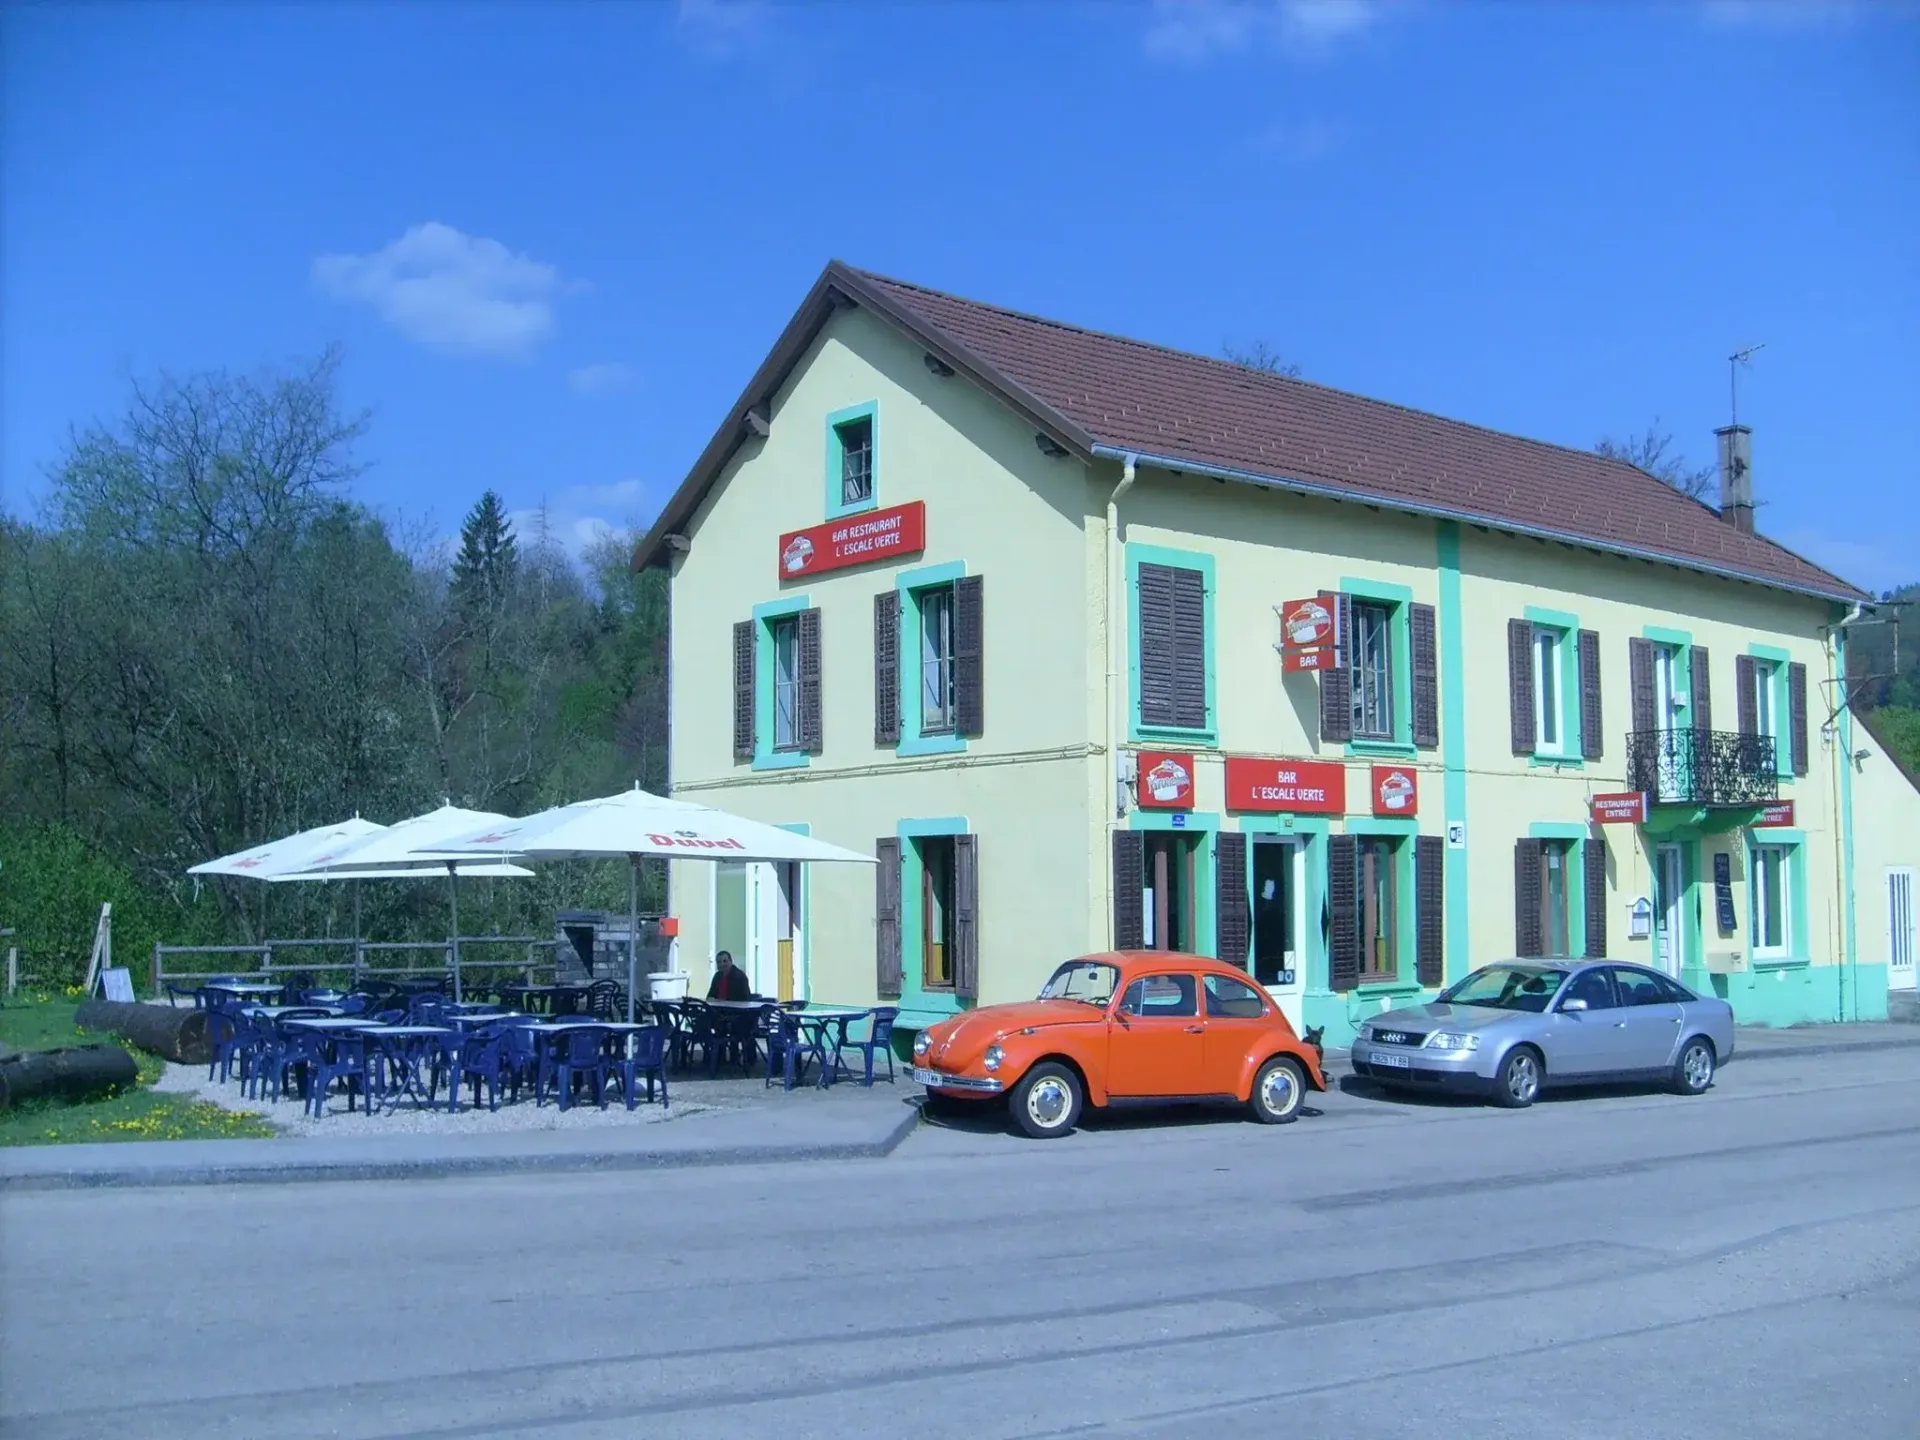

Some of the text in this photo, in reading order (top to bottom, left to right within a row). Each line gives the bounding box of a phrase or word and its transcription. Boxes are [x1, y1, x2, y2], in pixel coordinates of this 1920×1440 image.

[831, 515, 902, 543] BAR RESTAURANT
[874, 532, 901, 549] VERTE
[1299, 655, 1318, 668] BAR
[1277, 770, 1297, 784] BAR
[1296, 788, 1325, 802] VERTE
[1595, 799, 1640, 809] RESTAURANT
[1605, 808, 1633, 818] ENTRÉE
[644, 833, 747, 850] Duvel
